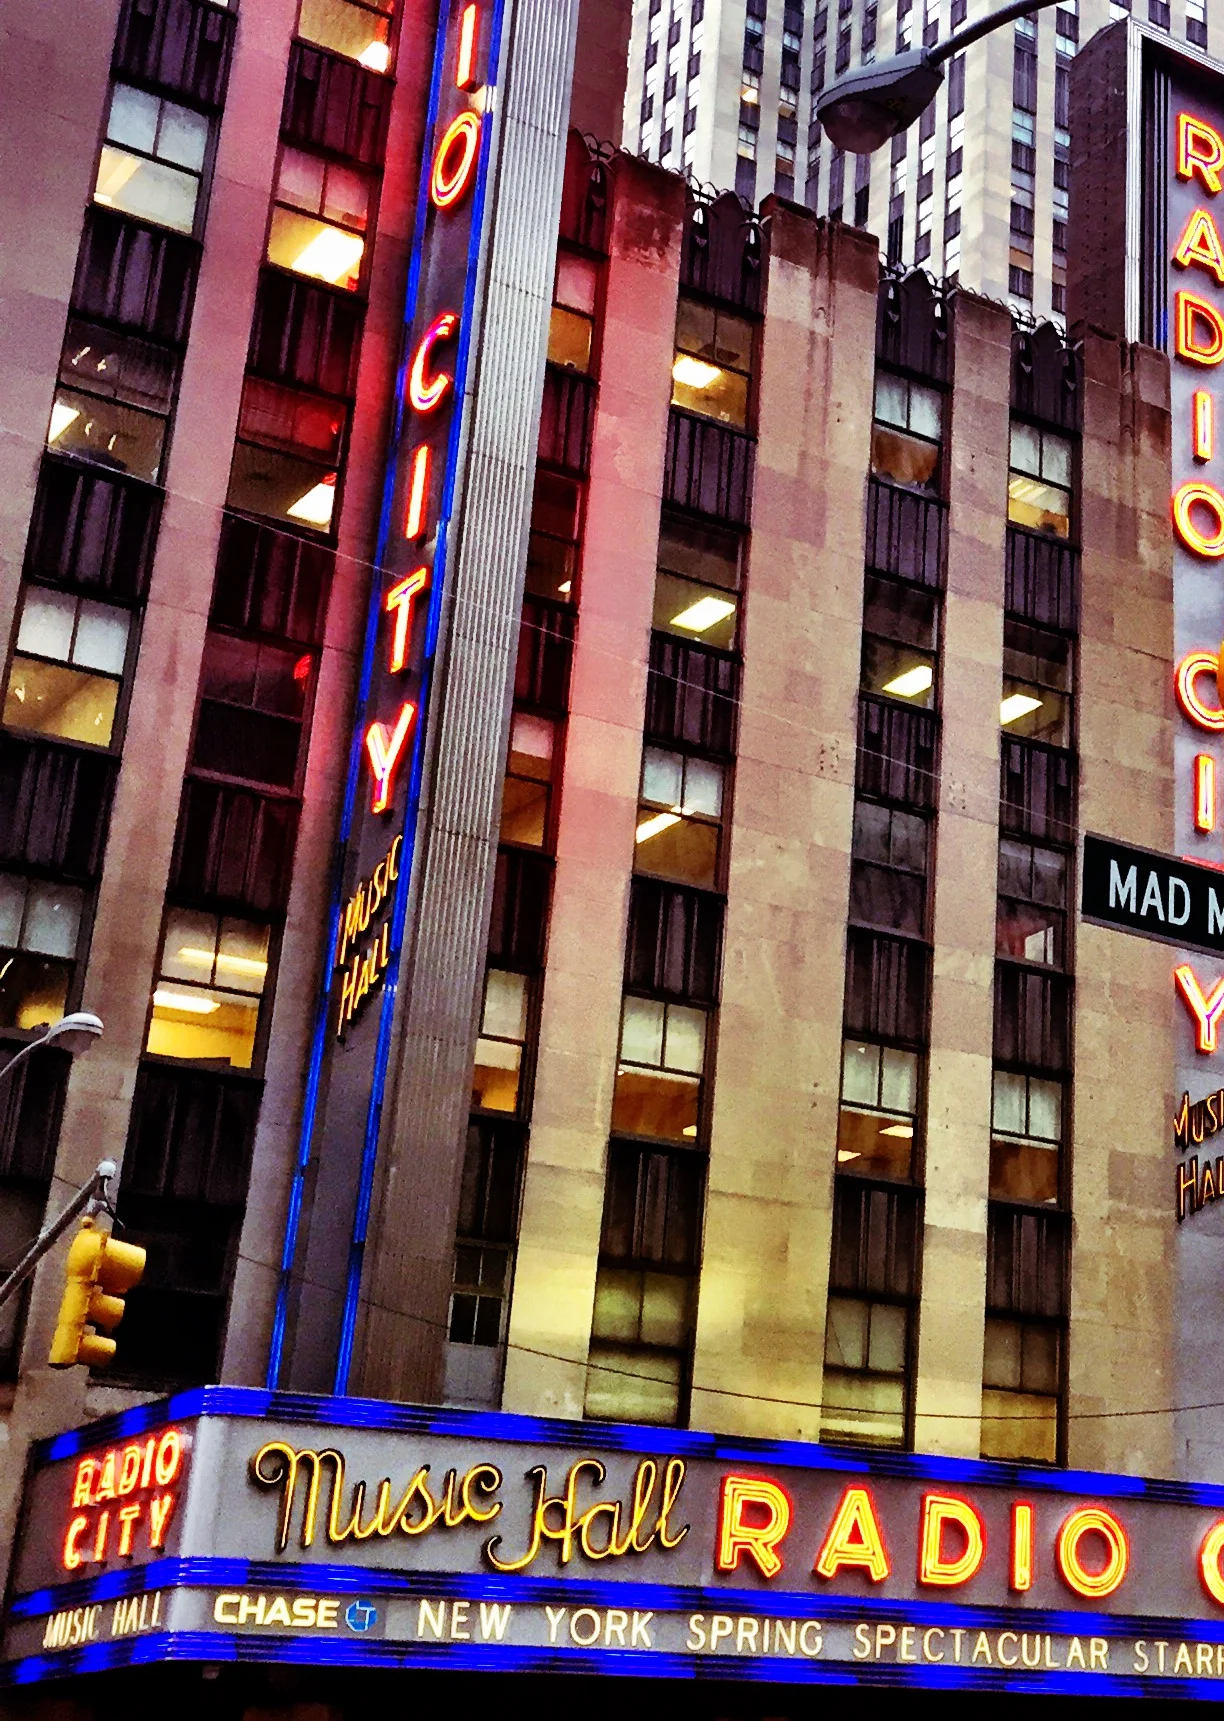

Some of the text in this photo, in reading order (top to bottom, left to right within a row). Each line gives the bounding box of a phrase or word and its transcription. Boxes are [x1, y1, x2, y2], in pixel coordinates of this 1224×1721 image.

[431, 2, 481, 209] IO
[365, 311, 461, 815] CITY
[1108, 858, 1192, 927] MAD
[335, 921, 390, 1037] HALL
[72, 1428, 184, 1509] RADIO
[63, 1492, 176, 1571] CITY
[254, 1441, 504, 1549] Music
[486, 1458, 691, 1572] Hall
[716, 1472, 1132, 1601] RADIO
[43, 1590, 163, 1649] MUSIC HALL
[213, 1593, 341, 1629] CHASE
[416, 1600, 513, 1640] NEW
[544, 1605, 655, 1648] YORK
[685, 1613, 824, 1657] SPRING
[852, 1623, 1110, 1671] SPECTACULAR
